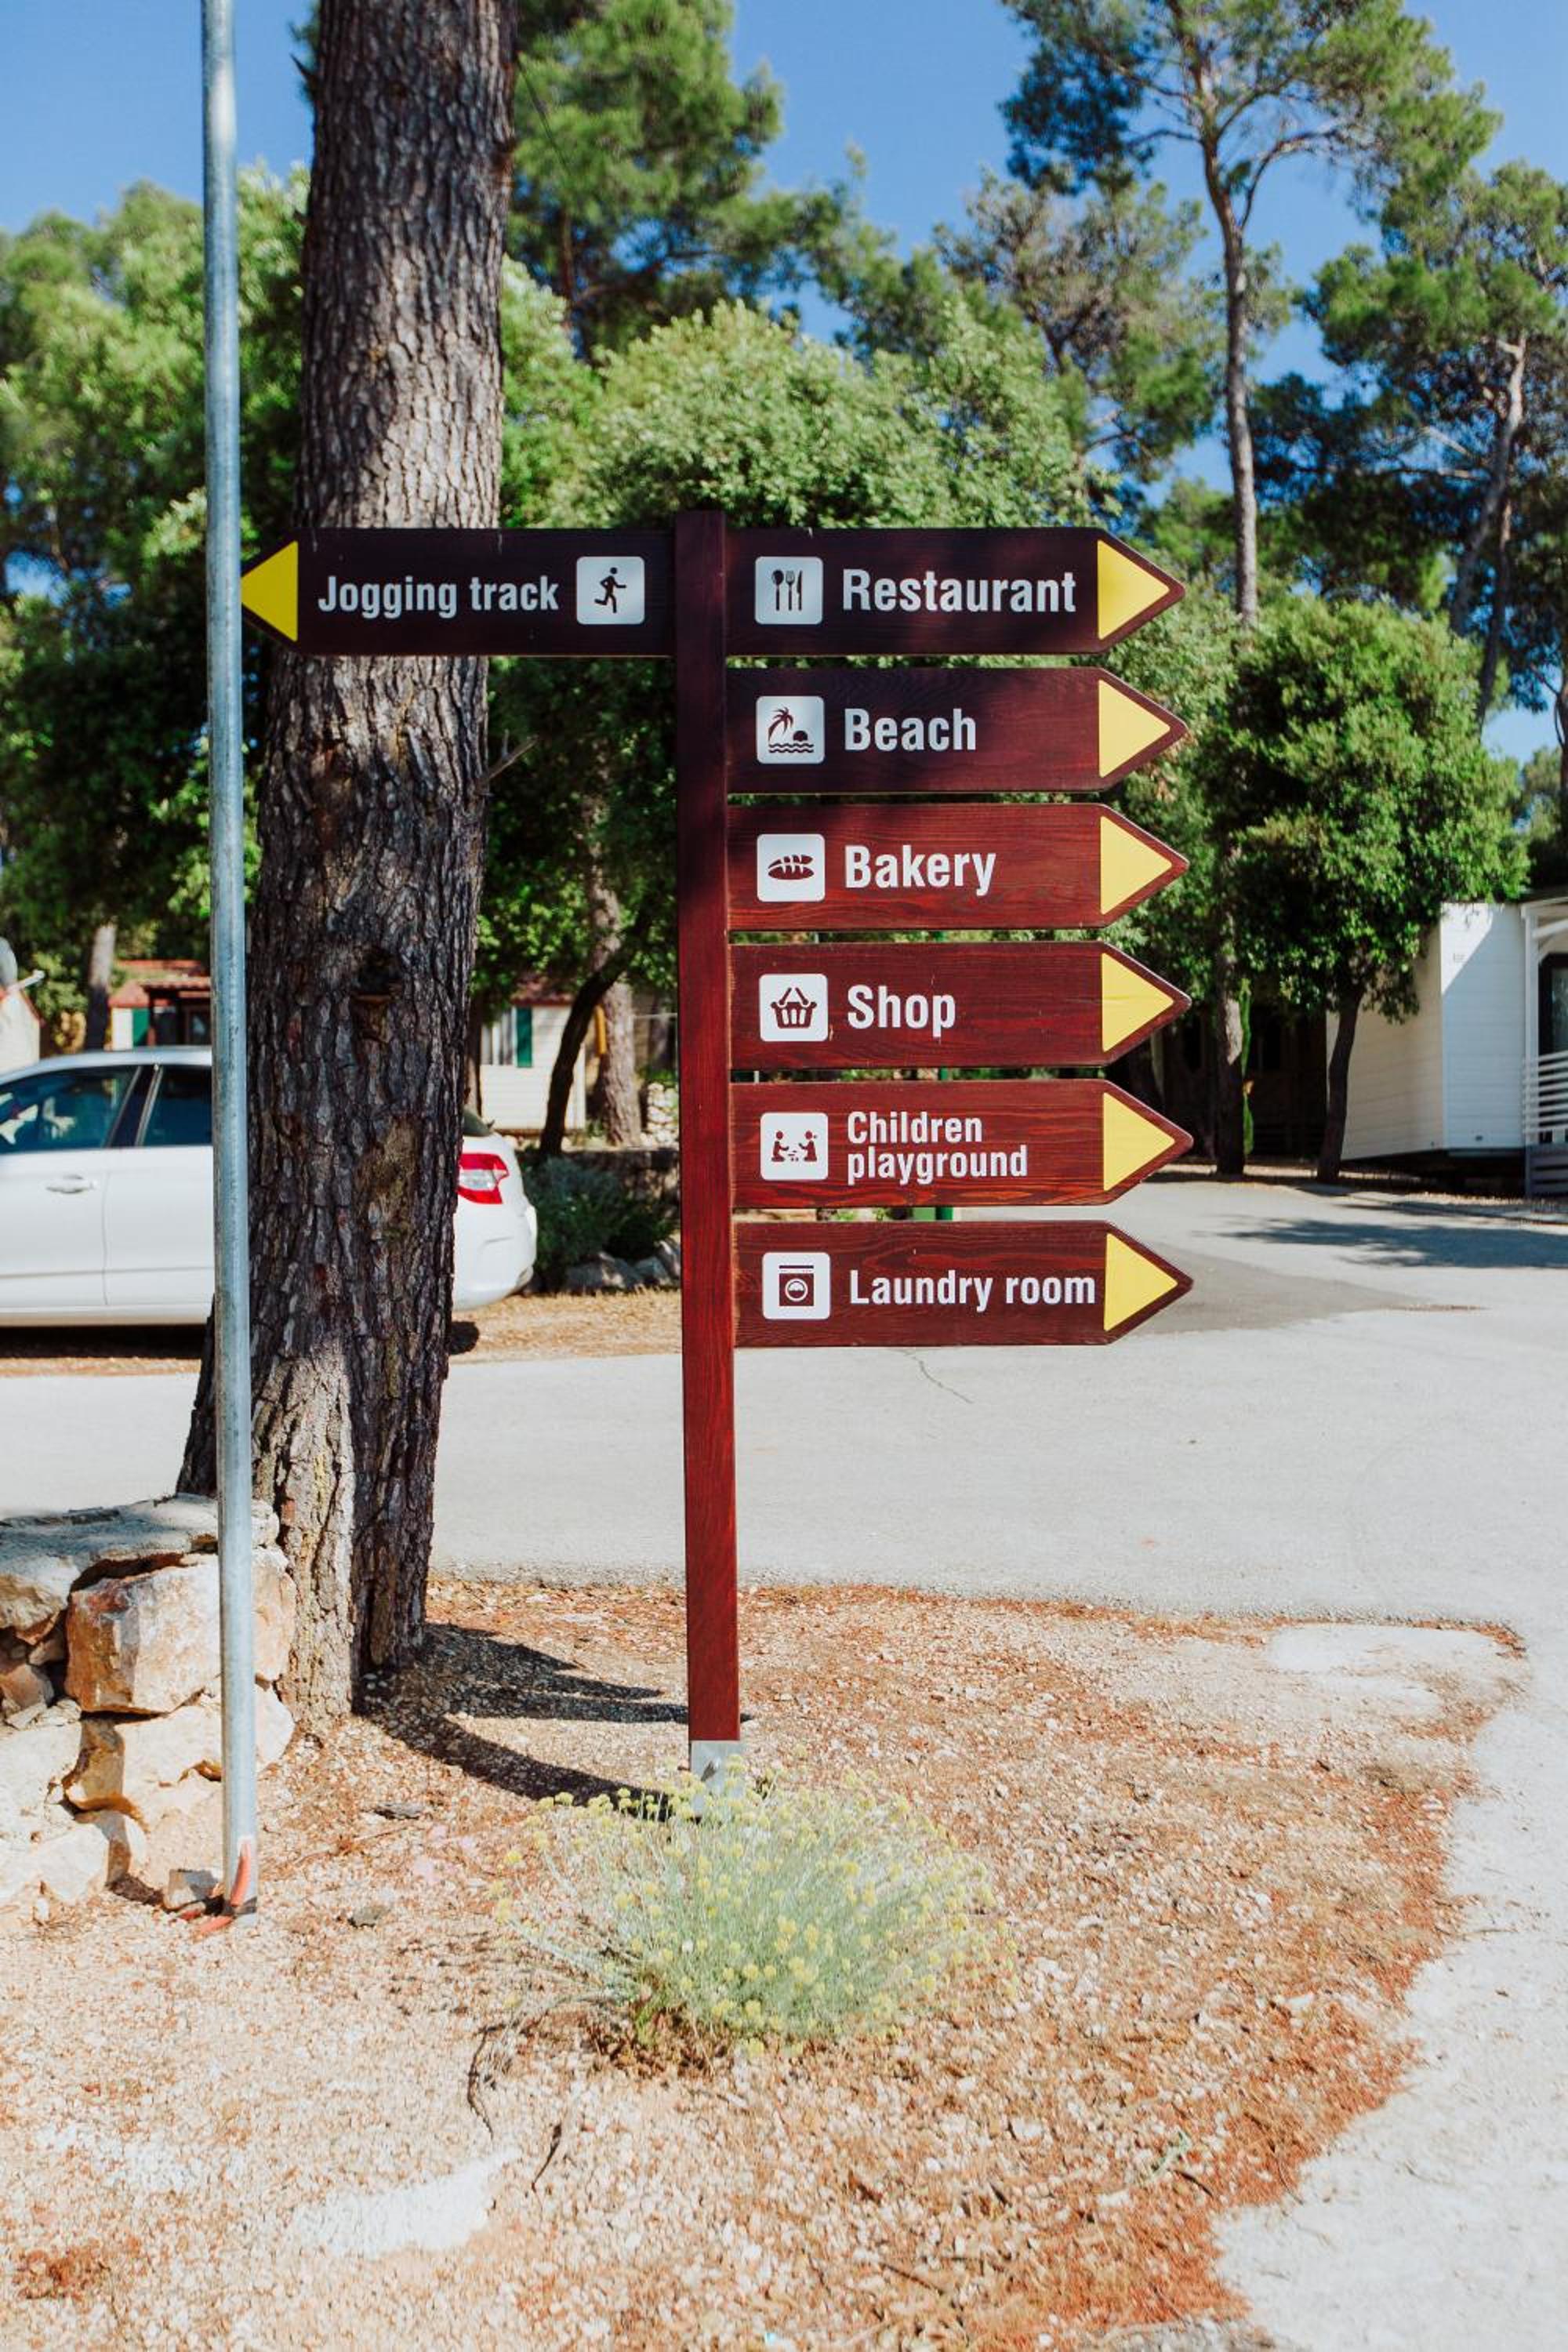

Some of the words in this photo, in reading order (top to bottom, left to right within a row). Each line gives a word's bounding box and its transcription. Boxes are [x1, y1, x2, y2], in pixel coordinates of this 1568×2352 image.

[318, 575, 457, 619] Jogging
[469, 575, 559, 611] track
[842, 568, 1076, 613] Restaurant
[844, 708, 977, 751] Beach
[844, 844, 996, 896] Bakery
[847, 985, 956, 1038] Shop
[847, 1111, 983, 1144] Children
[847, 1145, 1028, 1186] playground
[849, 1269, 993, 1312] Laundry
[1004, 1276, 1096, 1305] room
